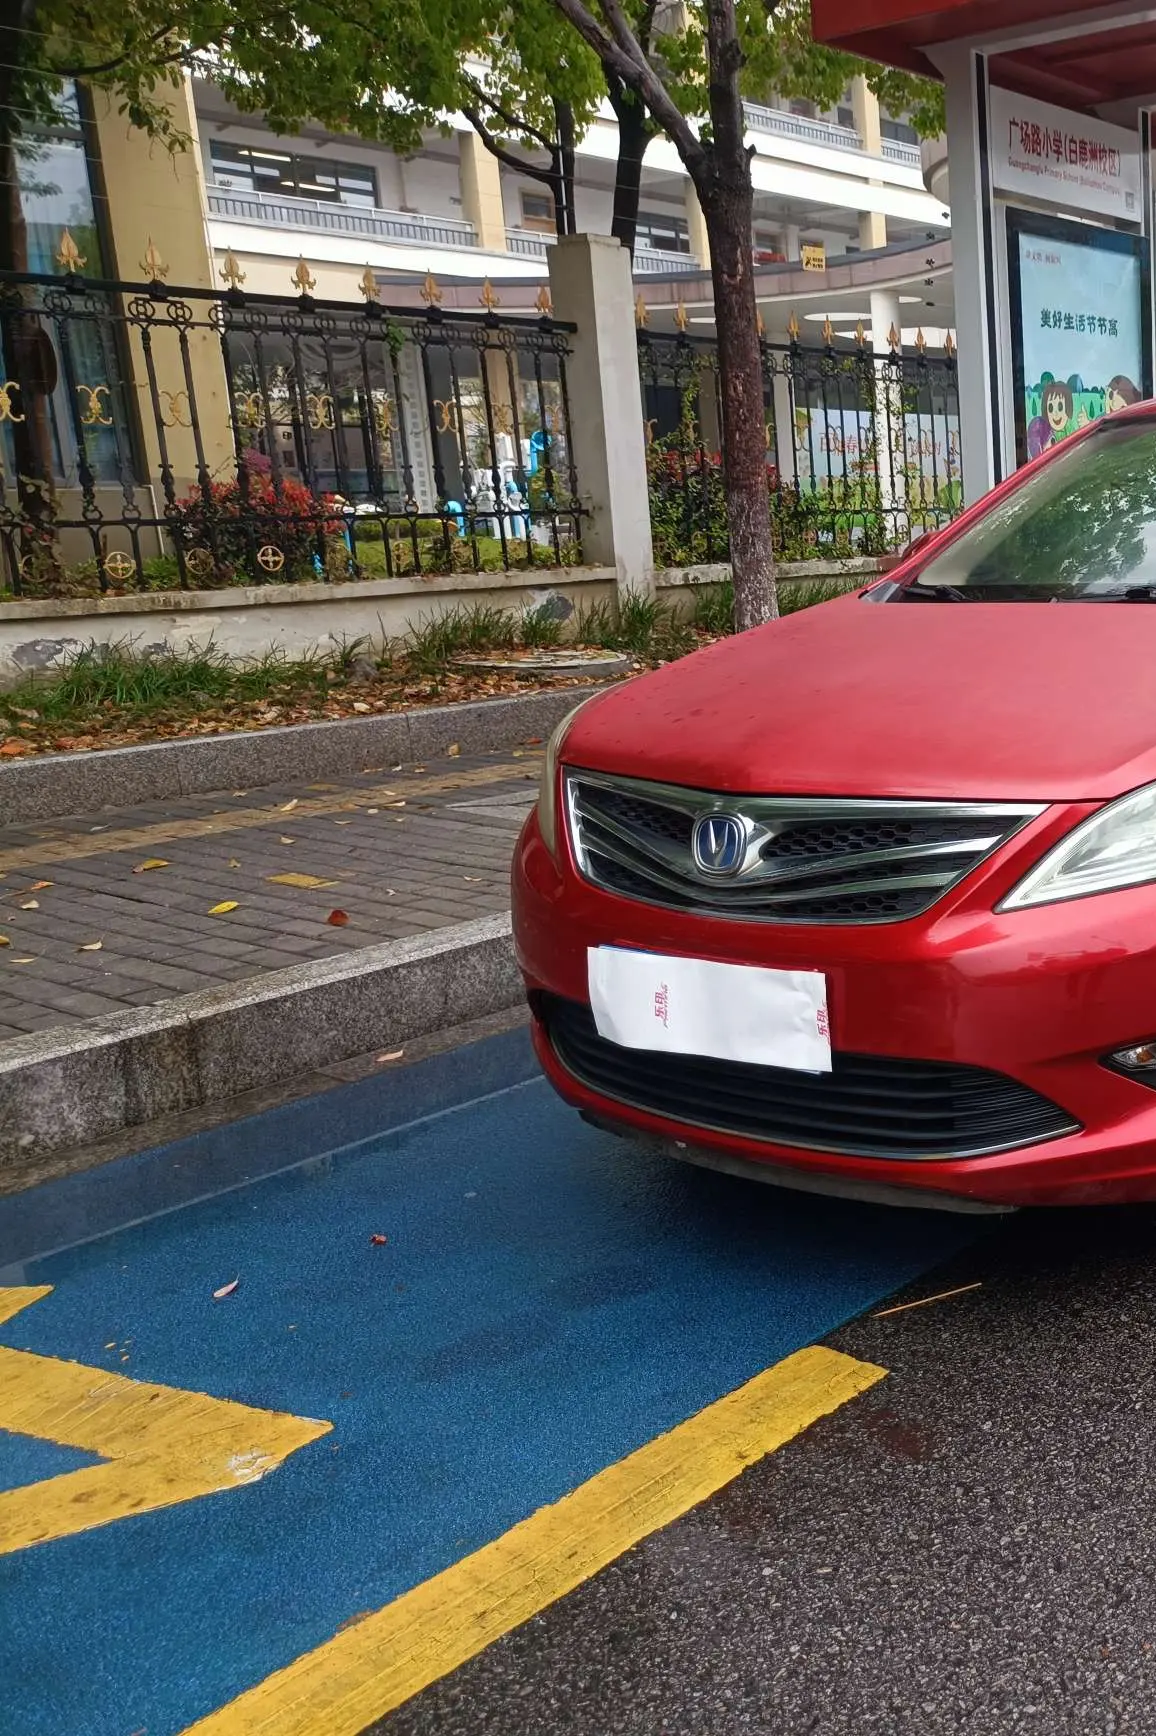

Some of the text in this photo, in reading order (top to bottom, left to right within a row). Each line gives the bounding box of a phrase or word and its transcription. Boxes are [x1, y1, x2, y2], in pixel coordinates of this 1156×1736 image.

[1040, 308, 1118, 337] 美好生活节节高
